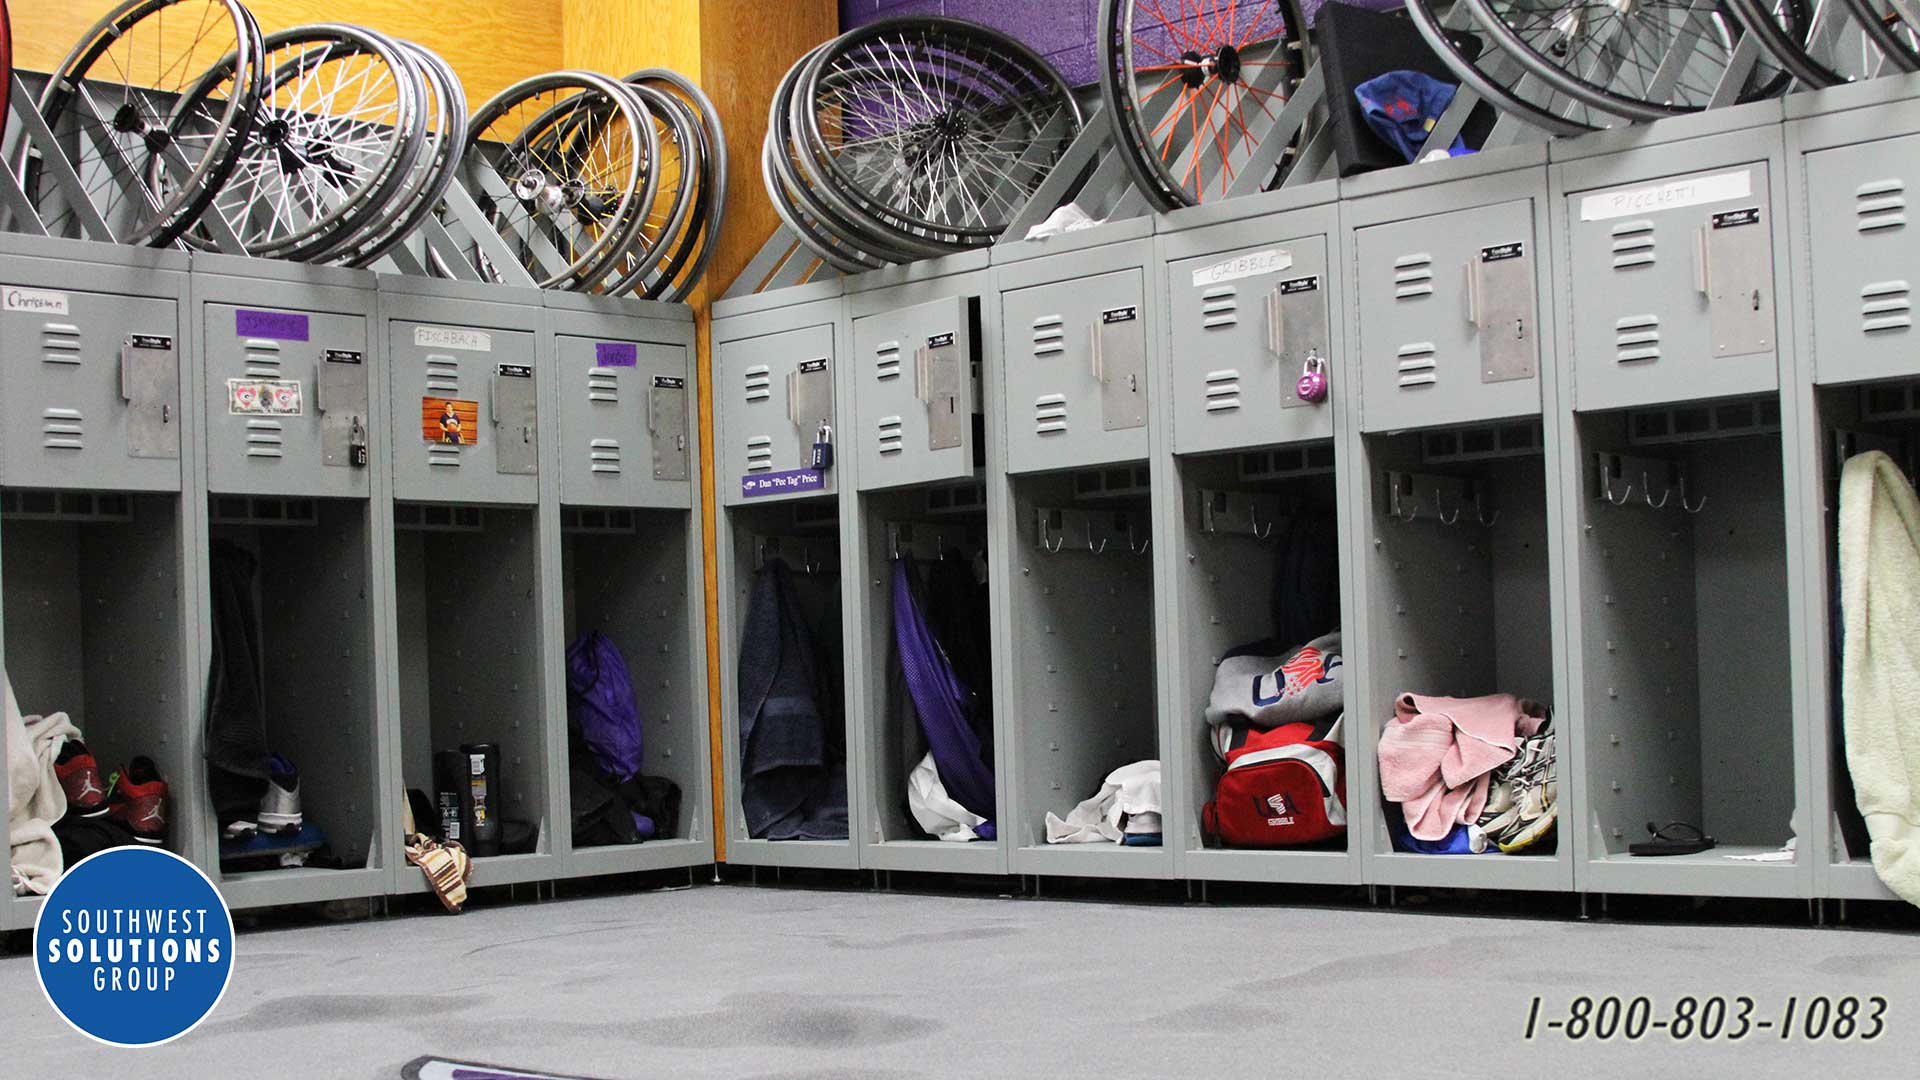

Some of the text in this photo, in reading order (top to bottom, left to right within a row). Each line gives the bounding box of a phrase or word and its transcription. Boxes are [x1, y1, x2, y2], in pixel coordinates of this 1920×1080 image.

[1211, 255, 1275, 280] GRIBBLE
[759, 479, 772, 489] Dan
[802, 474, 817, 484] Price
